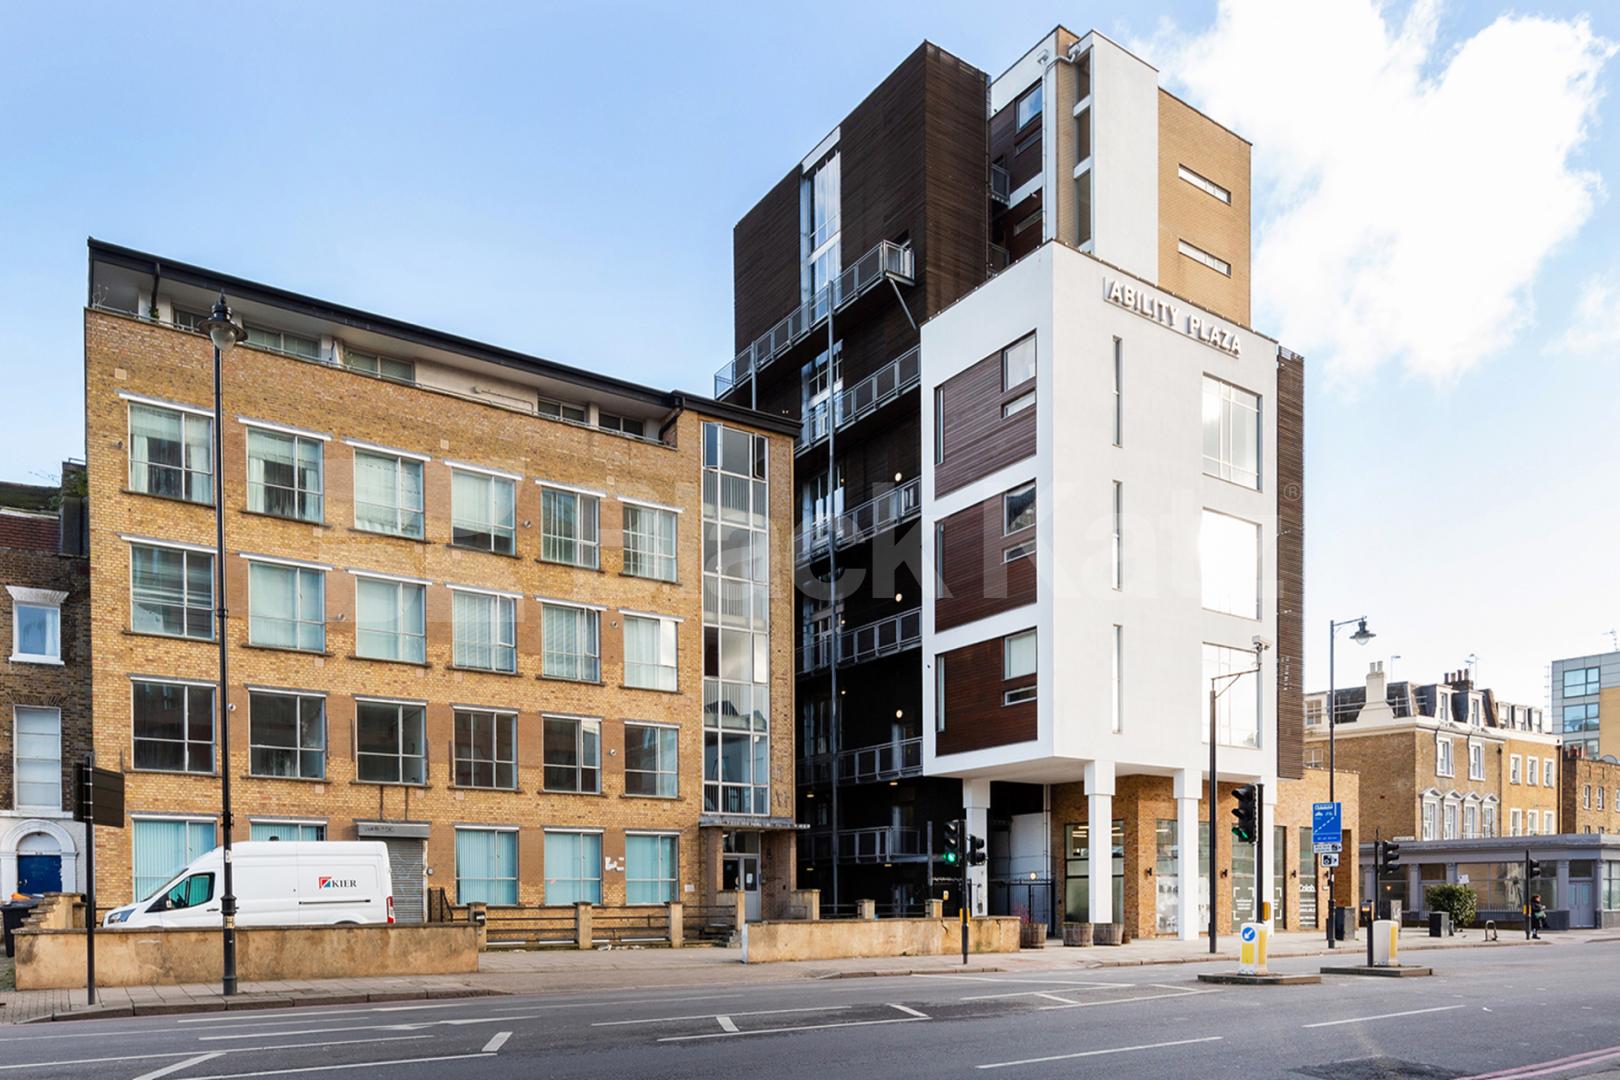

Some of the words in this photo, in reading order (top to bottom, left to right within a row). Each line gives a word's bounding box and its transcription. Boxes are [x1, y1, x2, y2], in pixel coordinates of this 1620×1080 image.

[1108, 279, 1180, 327] ABILITY
[1187, 313, 1242, 356] PLAZA
[332, 879, 357, 888] KIER
